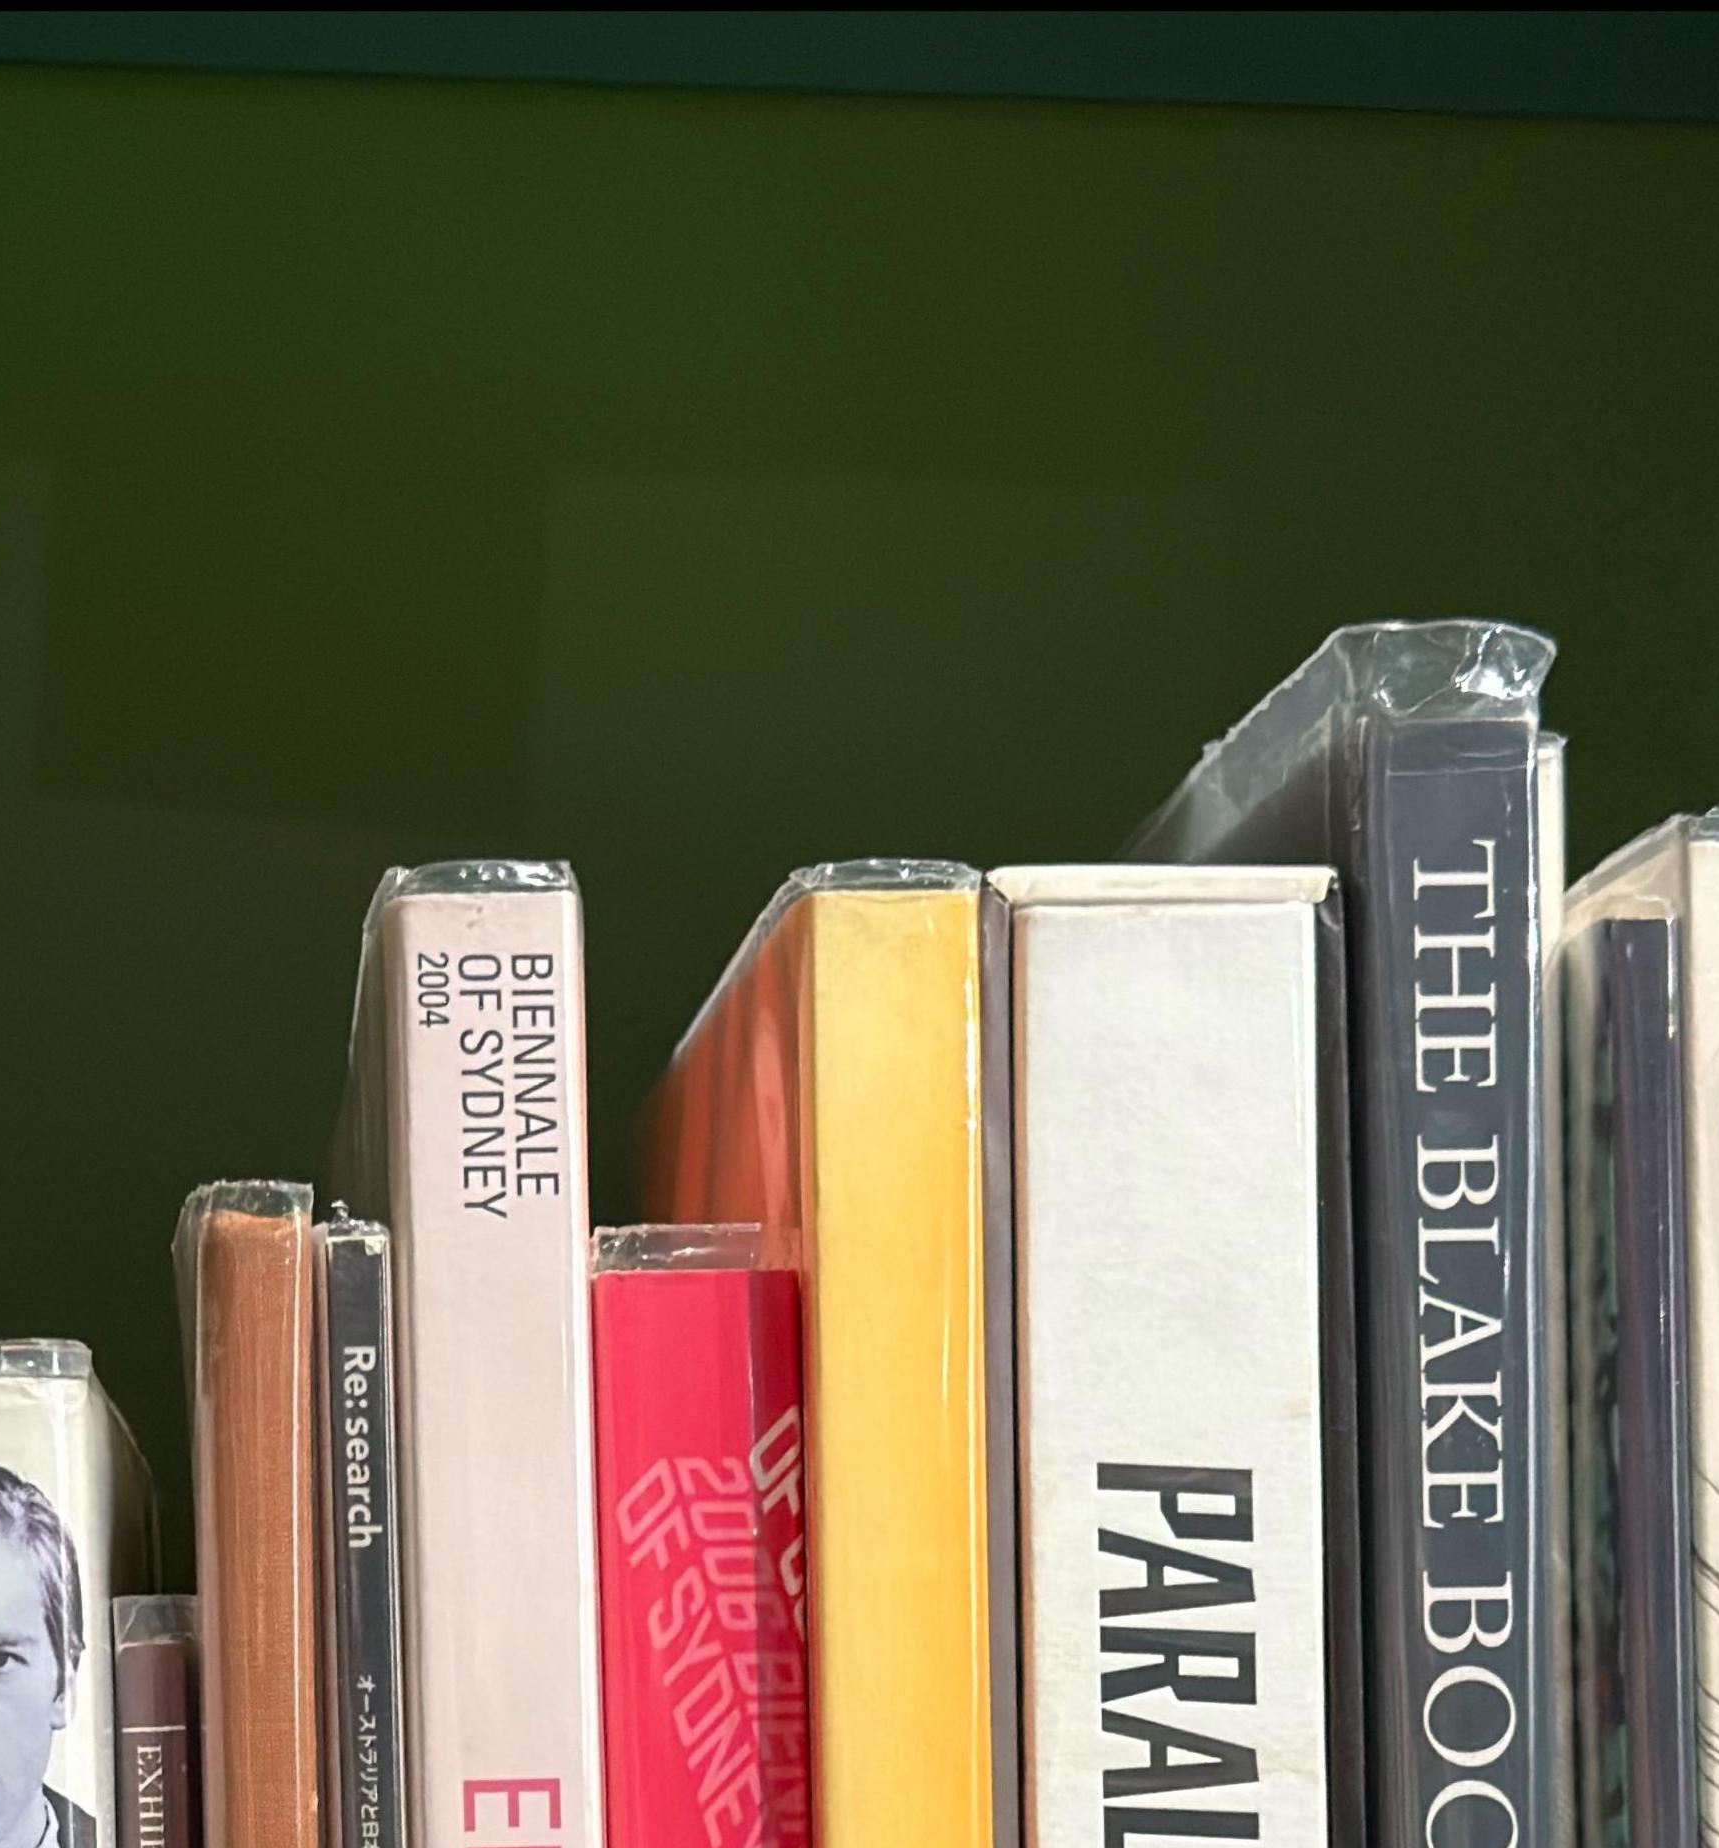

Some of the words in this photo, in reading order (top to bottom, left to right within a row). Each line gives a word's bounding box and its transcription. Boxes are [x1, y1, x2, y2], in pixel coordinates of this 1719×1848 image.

[417, 950, 451, 1029] 2004
[459, 951, 502, 1013] OF
[1412, 837, 1497, 1095] THE
[460, 1028, 509, 1222] SYDNEY
[511, 952, 559, 1199] BIENNALE
[1415, 1133, 1505, 1530] BLAKE
[342, 1421, 380, 1551] search
[616, 1458, 692, 1573] OF
